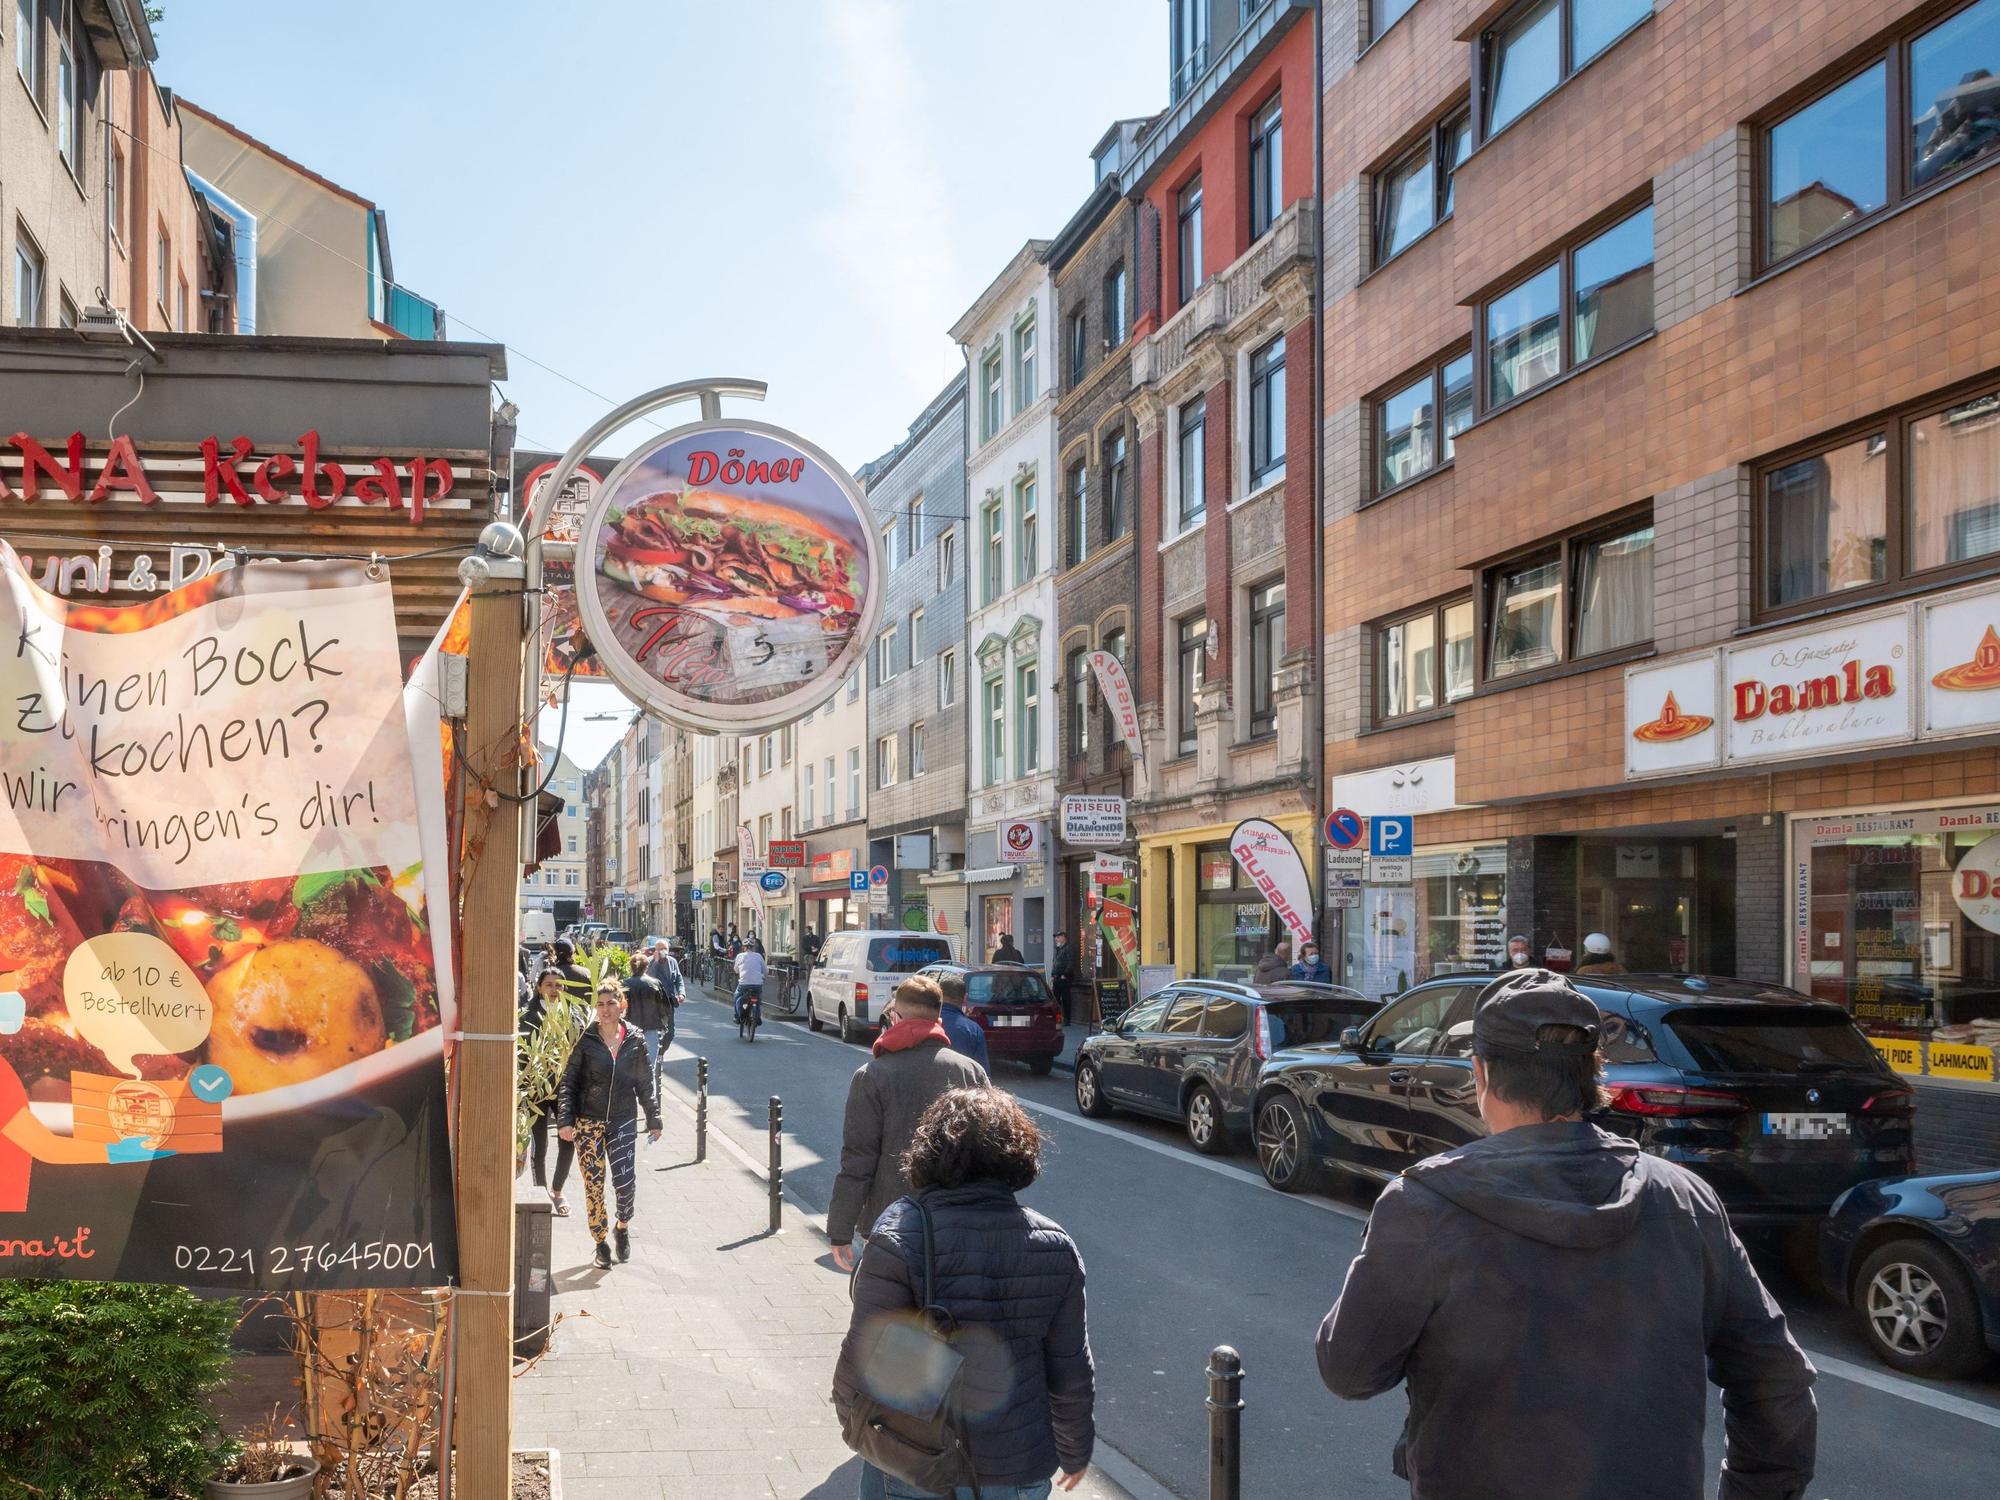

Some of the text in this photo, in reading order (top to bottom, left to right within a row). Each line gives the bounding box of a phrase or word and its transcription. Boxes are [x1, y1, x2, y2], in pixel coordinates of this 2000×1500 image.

[0, 429, 454, 525] NA Kebap
[686, 447, 805, 486] Döner
[20, 545, 113, 594] uni
[17, 604, 343, 715] Kinen Bock
[1733, 659, 1896, 723] Damla
[90, 699, 330, 779] kochen?
[3, 767, 76, 812] Wir
[299, 780, 380, 830] dir!
[1066, 803, 1121, 814] FRISEUR
[1066, 822, 1124, 832] DIAMONDS
[1816, 819, 1914, 835] Damla RESTAURANT
[1939, 814, 1982, 826] Damla
[1380, 820, 1403, 852] P
[1328, 854, 1361, 864] Ladezone
[765, 878, 784, 886] EFES
[854, 873, 865, 888] P
[1799, 862, 1808, 926] RESTAURANT
[100, 961, 183, 989] ab 10 €
[80, 991, 207, 1021] Bestellwert
[1932, 1053, 1988, 1071] LAHMACUN
[174, 1241, 437, 1275] 0221 27645001
